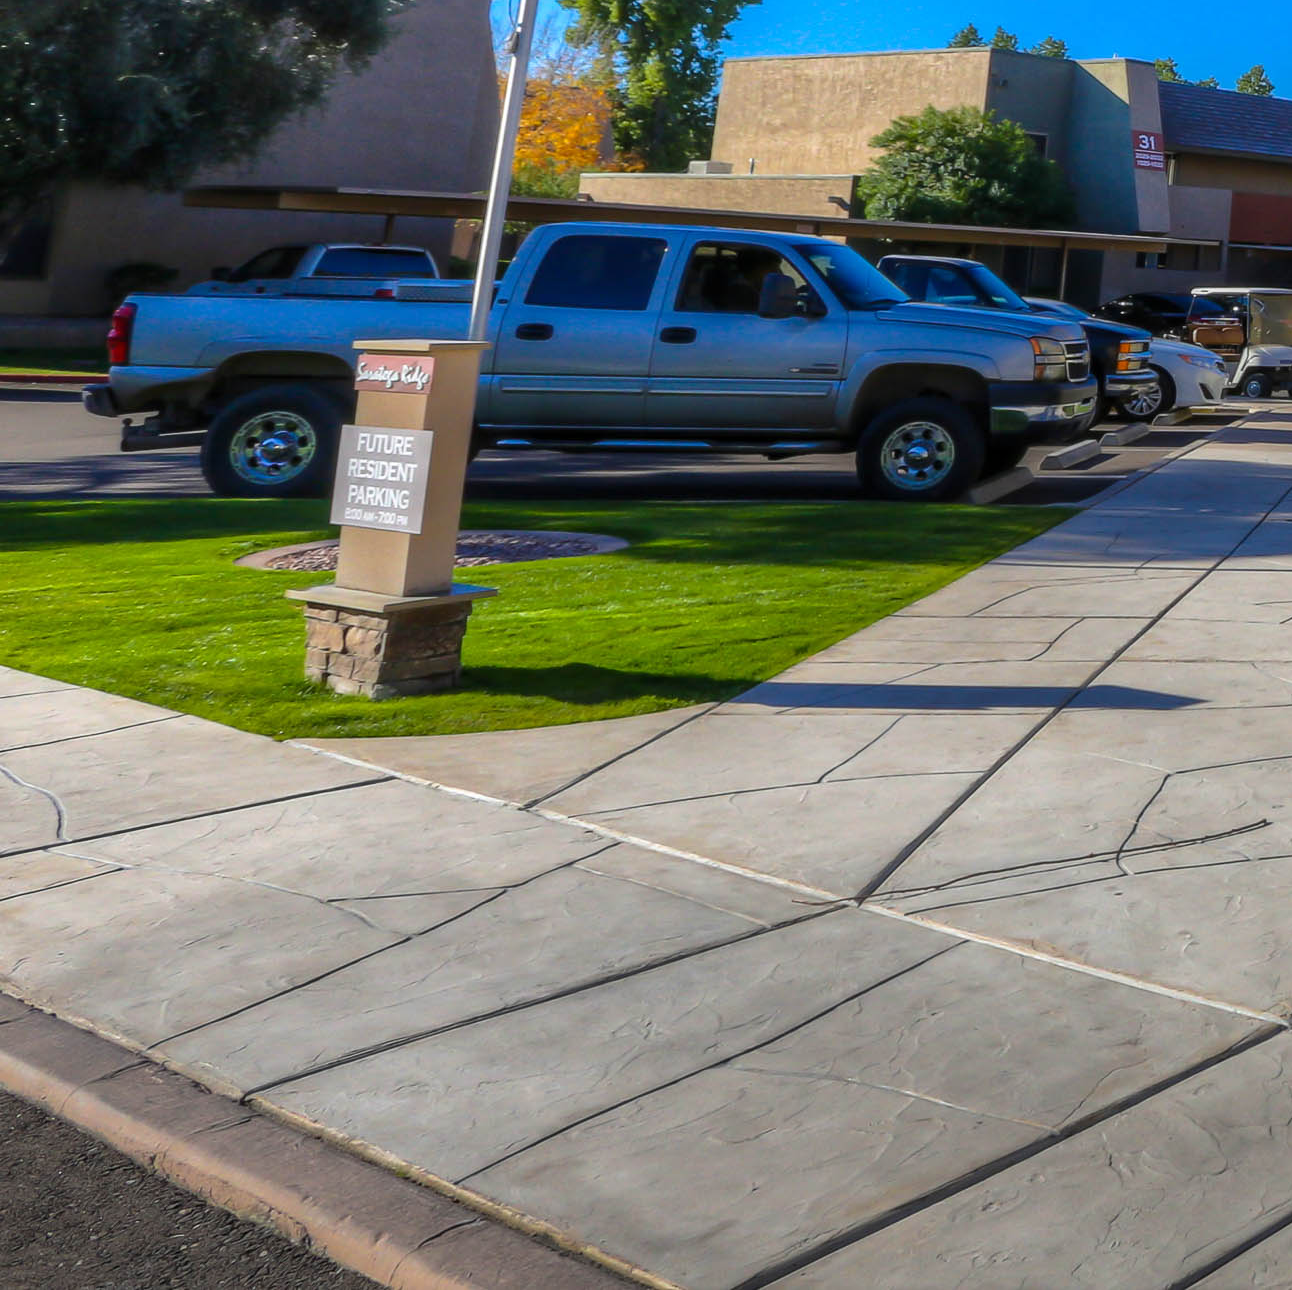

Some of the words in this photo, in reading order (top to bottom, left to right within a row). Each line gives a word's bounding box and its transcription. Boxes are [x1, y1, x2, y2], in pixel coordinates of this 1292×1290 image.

[1138, 134, 1156, 150] 31
[356, 362, 400, 389] Saratoga
[400, 364, 430, 391] Ridge
[357, 432, 415, 456] FUTURE
[347, 458, 418, 483] RESIDENT
[347, 484, 410, 509] PARKING
